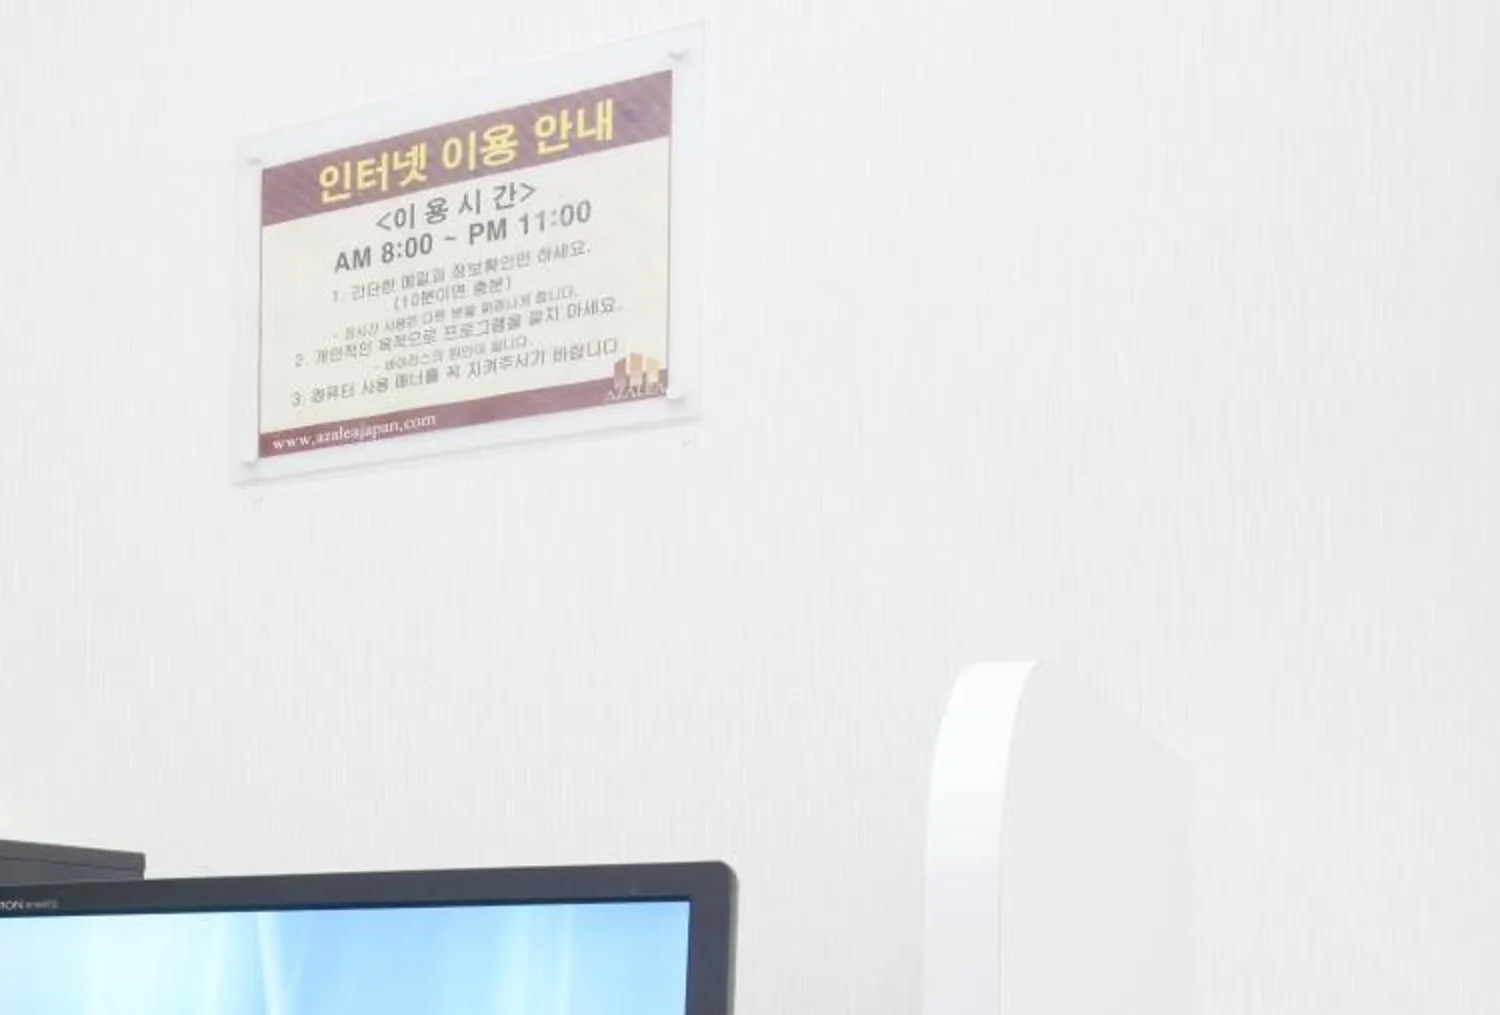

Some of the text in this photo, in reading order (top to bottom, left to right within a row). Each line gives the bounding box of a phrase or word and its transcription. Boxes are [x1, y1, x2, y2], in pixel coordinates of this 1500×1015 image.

[320, 98, 612, 203] 인터넷 이용 안내
[335, 246, 371, 272] AM
[381, 232, 433, 264] 8:00
[469, 217, 506, 246] PM
[518, 200, 592, 235] 11:00
[273, 415, 438, 449] www.azaleajapan.com
